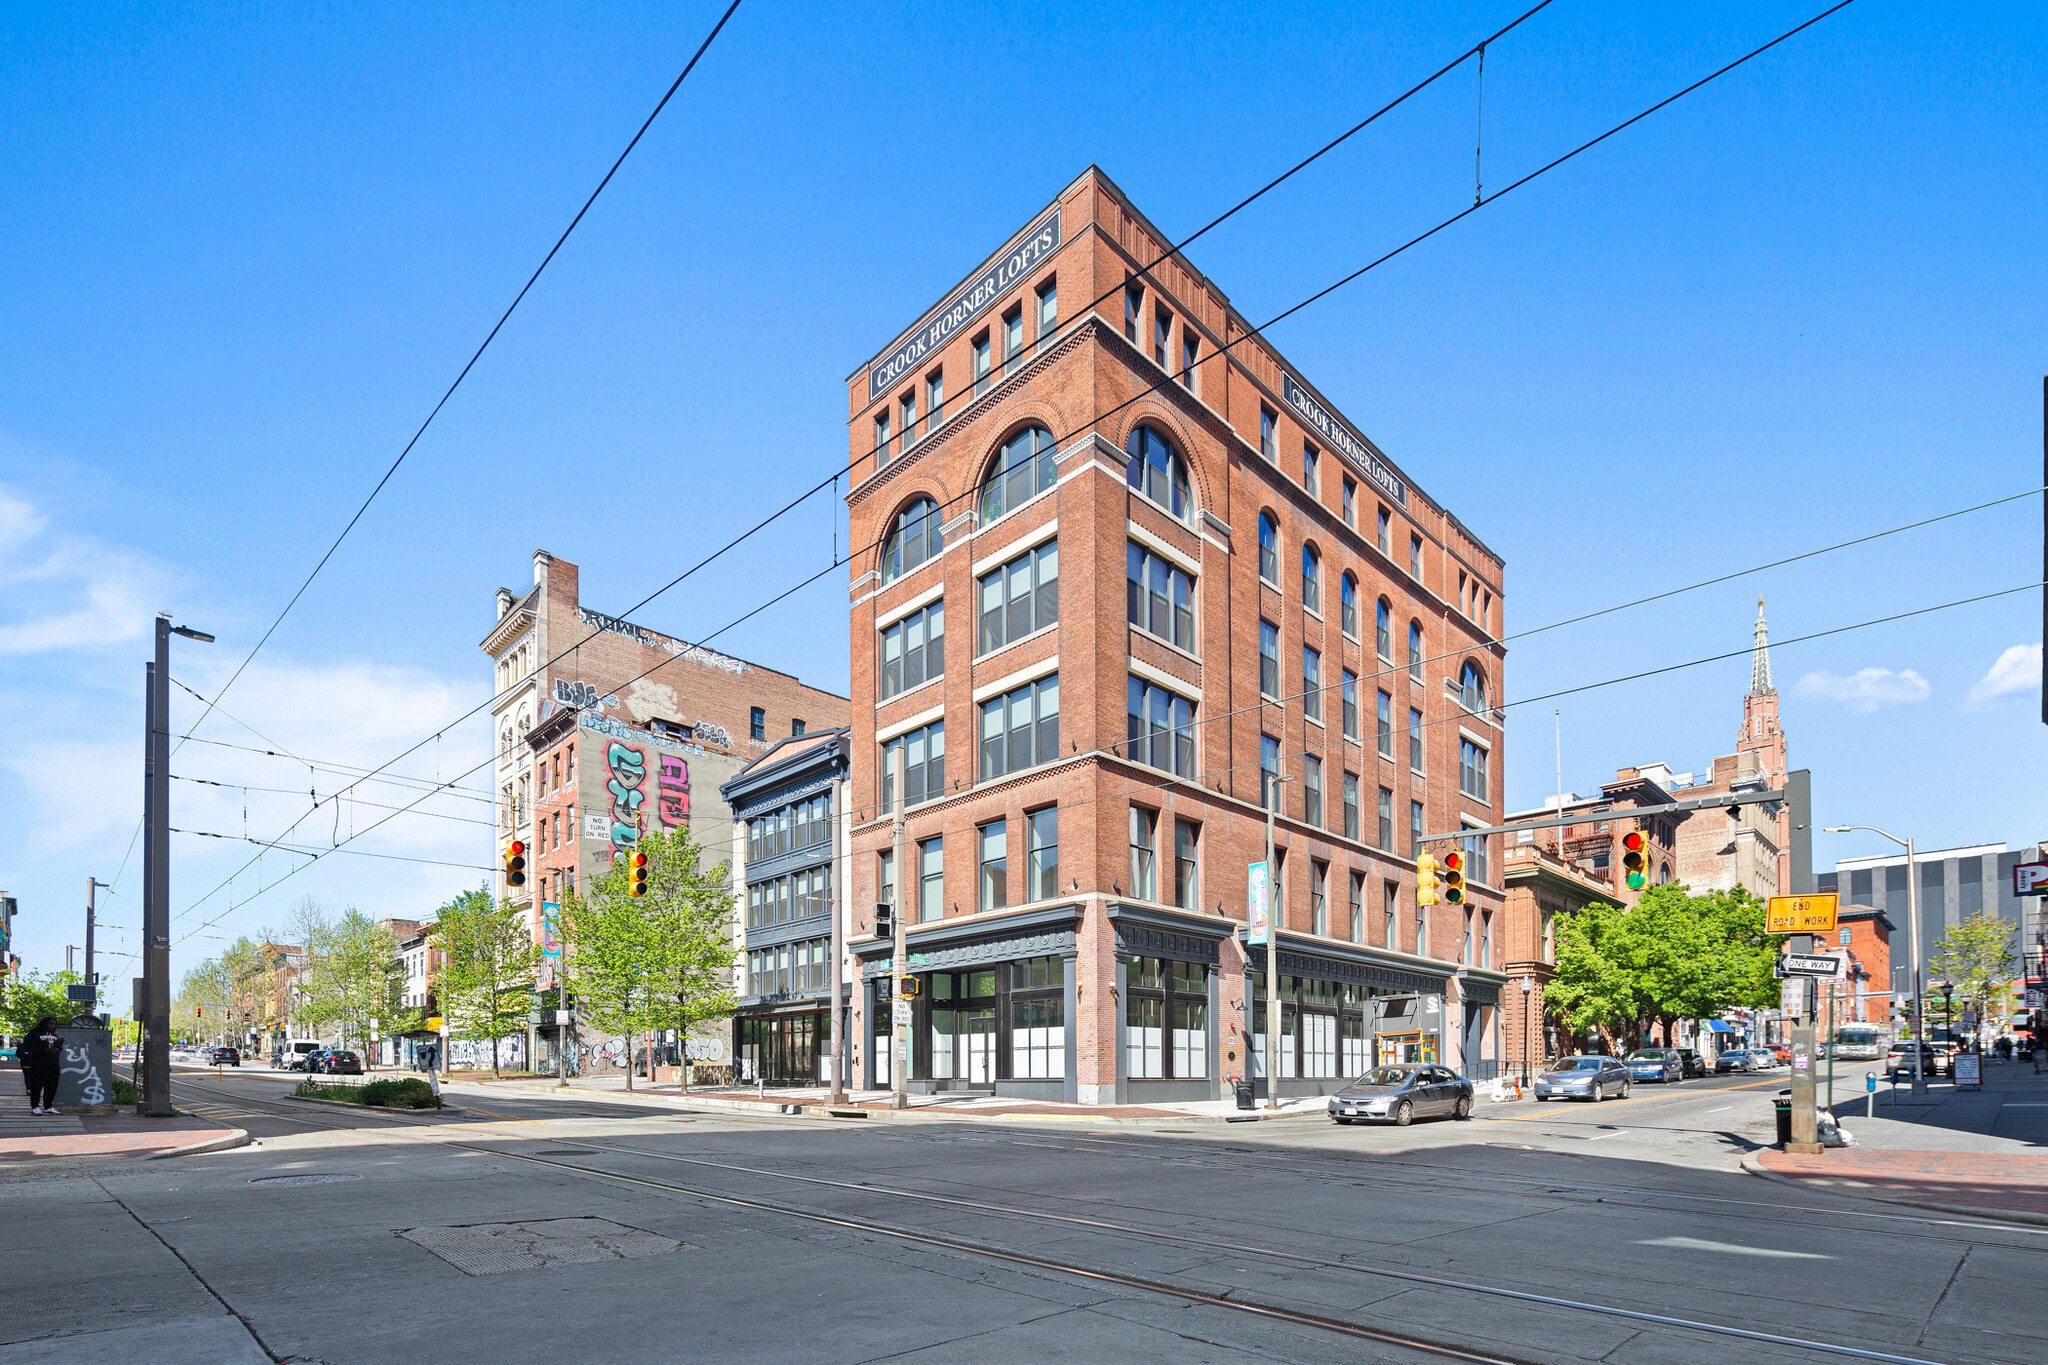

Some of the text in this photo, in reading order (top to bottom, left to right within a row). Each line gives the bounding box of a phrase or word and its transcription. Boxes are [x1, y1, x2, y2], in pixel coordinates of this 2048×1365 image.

[877, 227, 1052, 388] CROOK HORNER LOFTS
[1291, 388, 1399, 497] CROOK HORNER LOFTS
[1792, 901, 1811, 911] END
[1773, 916, 1829, 927] ROAD WORK
[1788, 959, 1832, 969] ONE WAY
